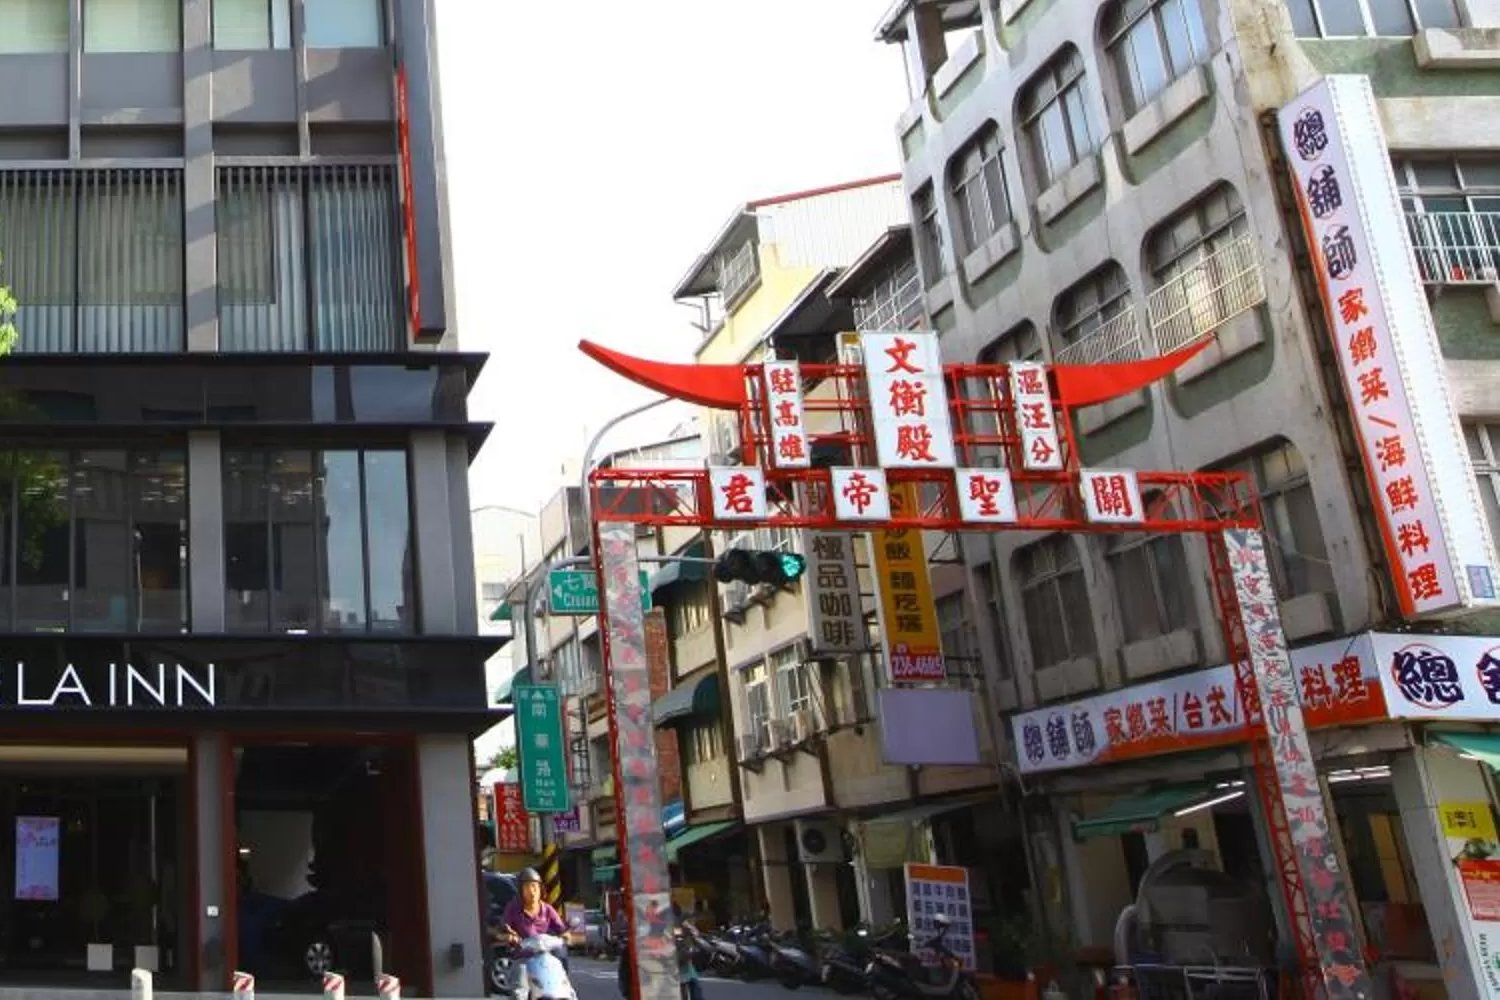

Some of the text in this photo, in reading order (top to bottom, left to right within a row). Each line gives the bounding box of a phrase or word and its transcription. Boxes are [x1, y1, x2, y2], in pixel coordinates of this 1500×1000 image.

[770, 368, 806, 461] 駐高雄
[884, 338, 937, 464] 文衡殿
[17, 663, 93, 706] LA
[108, 663, 215, 706] INN
